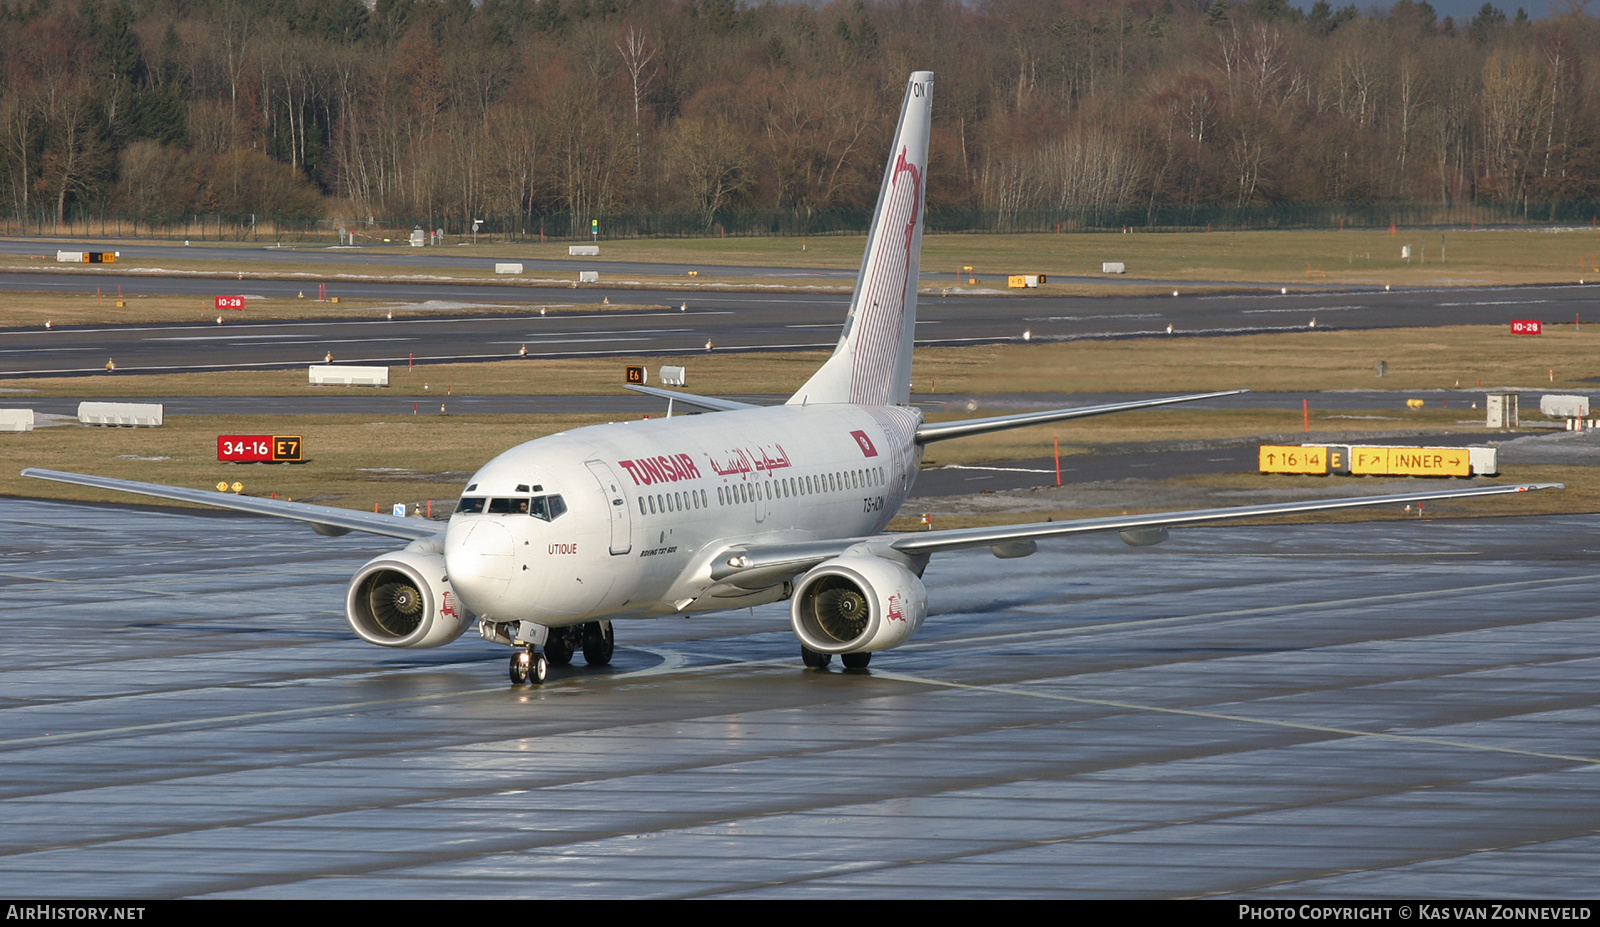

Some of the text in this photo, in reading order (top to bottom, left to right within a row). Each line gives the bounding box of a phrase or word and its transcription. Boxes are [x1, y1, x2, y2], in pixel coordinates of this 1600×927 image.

[914, 82, 925, 97] ON
[218, 298, 241, 306] 10-28
[1513, 322, 1538, 332] 10-28
[630, 370, 639, 380] E6
[223, 441, 268, 455] 34-16
[277, 441, 298, 455] E7
[1331, 453, 1341, 468] E
[1358, 454, 1367, 467] F
[1395, 455, 1443, 468] INNER
[618, 453, 701, 486] TUNISAIR
[640, 548, 658, 557] BOEING
